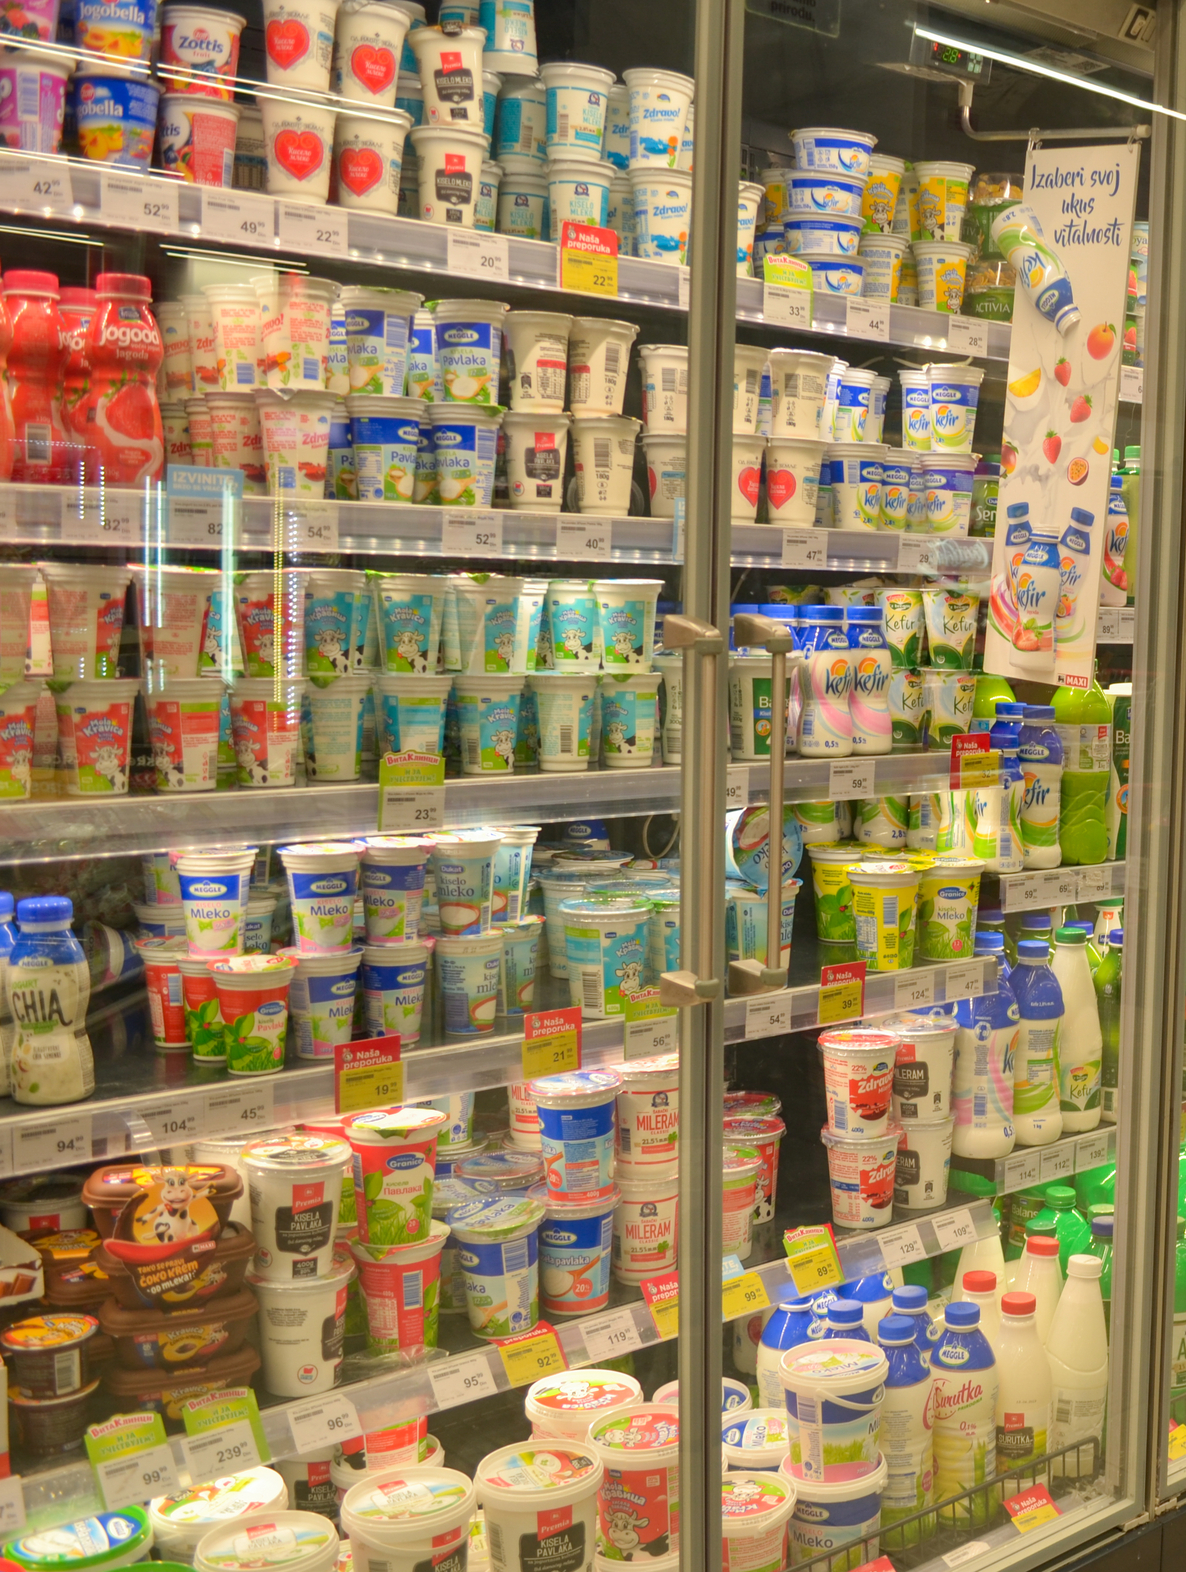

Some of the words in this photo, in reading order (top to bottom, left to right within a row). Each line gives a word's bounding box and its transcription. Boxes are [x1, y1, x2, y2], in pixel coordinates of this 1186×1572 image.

[80, 1, 145, 24] Jogobella
[179, 35, 224, 54] Zottis
[436, 76, 456, 85] KISELO
[455, 76, 473, 85] MLEKO
[643, 108, 680, 120] Zdravo!
[436, 178, 455, 187] KISELO
[454, 177, 472, 188] MLEKO
[1030, 164, 1087, 191] Izaberi
[1090, 163, 1120, 197] svoj
[33, 181, 52, 195] 42
[144, 203, 160, 216] 52
[653, 203, 688, 217] Zdravo!
[1061, 192, 1096, 219] ukus
[240, 221, 257, 234] 49
[1053, 216, 1126, 248] vitalnosti
[316, 229, 332, 243] 22
[579, 232, 600, 244] Naša
[567, 240, 611, 254] preporuka
[481, 256, 495, 268] 20
[593, 275, 606, 286] 22
[975, 302, 1011, 313] ACTIVIA
[869, 320, 880, 330] 44
[100, 324, 159, 347] jogood
[448, 331, 474, 339] MEGGLE
[969, 336, 978, 347] 28
[116, 349, 149, 361] Jagoda
[443, 354, 486, 368] Pavlaka
[933, 391, 958, 399] MEGGLE
[935, 408, 959, 428] kefir
[307, 525, 323, 538] 54
[476, 533, 489, 545] 52
[586, 539, 599, 550] 40
[309, 610, 347, 623] Кравица
[389, 612, 425, 626] Kravica
[885, 613, 915, 633] Kefir
[943, 614, 974, 635] Kefir
[854, 664, 889, 697] kefir
[1066, 675, 1088, 688] MAXI
[83, 724, 123, 738] Kravica
[963, 741, 978, 750] Naša
[1019, 748, 1045, 756] MEGGLE
[415, 808, 429, 820] 23
[441, 865, 464, 874] Dukat
[194, 885, 223, 894] MEGGLE
[315, 882, 343, 891] MEGGLE
[939, 889, 966, 898] Granice
[190, 908, 231, 919] Mleko
[310, 905, 349, 917] Mleko
[937, 910, 966, 920] Mleko
[836, 971, 852, 981] Naša
[911, 989, 925, 1000] 124
[12, 988, 73, 1027] CHIA
[257, 1022, 285, 1033] Pavlaka
[543, 1017, 564, 1028] Naša
[532, 1023, 575, 1037] preporuka
[356, 1049, 380, 1061] Naša
[553, 1051, 565, 1062] 21
[343, 1054, 393, 1071] preporuka
[374, 1084, 389, 1095] 19
[1070, 1082, 1092, 1100] Kefir
[241, 1108, 257, 1120] 45
[162, 1120, 187, 1134] 104
[636, 1113, 679, 1132] MILERAM
[57, 1139, 75, 1152] 94
[389, 1157, 424, 1168] Granice
[383, 1184, 423, 1196] Павлака
[295, 1196, 322, 1208] Premia
[294, 1211, 321, 1222] KISELA
[290, 1218, 322, 1231] PAVLAKA
[625, 1220, 671, 1240] MILERAM
[545, 1233, 571, 1241] MEGGLE
[555, 1256, 591, 1267] pavlaka
[140, 1271, 167, 1288] ČOKO
[503, 1327, 548, 1345] preporuka
[608, 1331, 626, 1345] 119
[941, 1349, 966, 1360] MEGGLE
[537, 1355, 551, 1368] 92
[464, 1376, 479, 1389] 95
[188, 1388, 247, 1411] ВитаКлинци
[934, 1379, 983, 1411] Surutka
[91, 1413, 154, 1438] ВитаКлинци
[327, 1418, 343, 1430] 96
[217, 1447, 241, 1463] 239
[143, 1472, 160, 1485] 99
[601, 1487, 646, 1506] Кравица
[795, 1507, 824, 1518] MEGGLE
[541, 1517, 570, 1533] Premia
[541, 1535, 569, 1549] KISELA
[793, 1531, 834, 1549] Mleko
[537, 1541, 573, 1557] PAVLAKA
